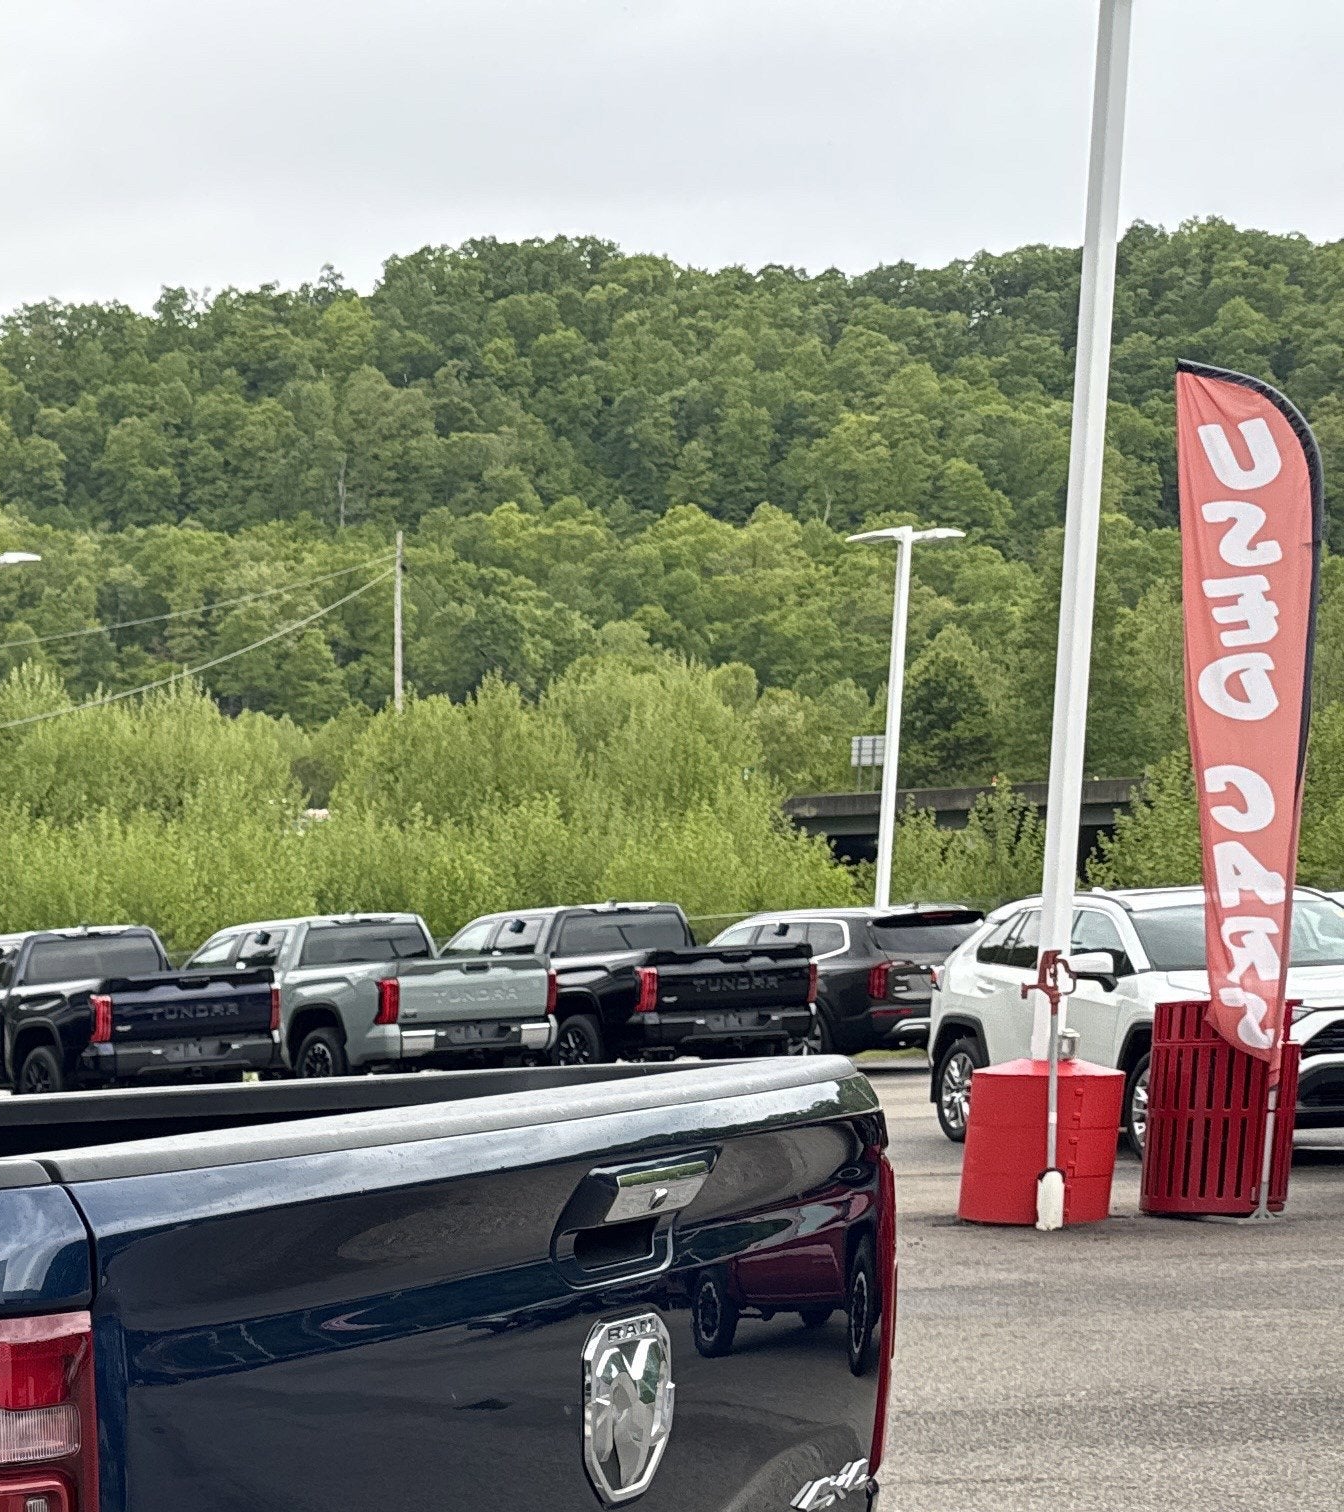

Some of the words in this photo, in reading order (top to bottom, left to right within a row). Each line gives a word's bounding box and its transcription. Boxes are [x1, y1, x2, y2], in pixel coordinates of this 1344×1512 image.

[692, 975, 779, 993] TUNDRA
[152, 1002, 240, 1021] TUNDRA
[607, 1318, 658, 1343] RAM
